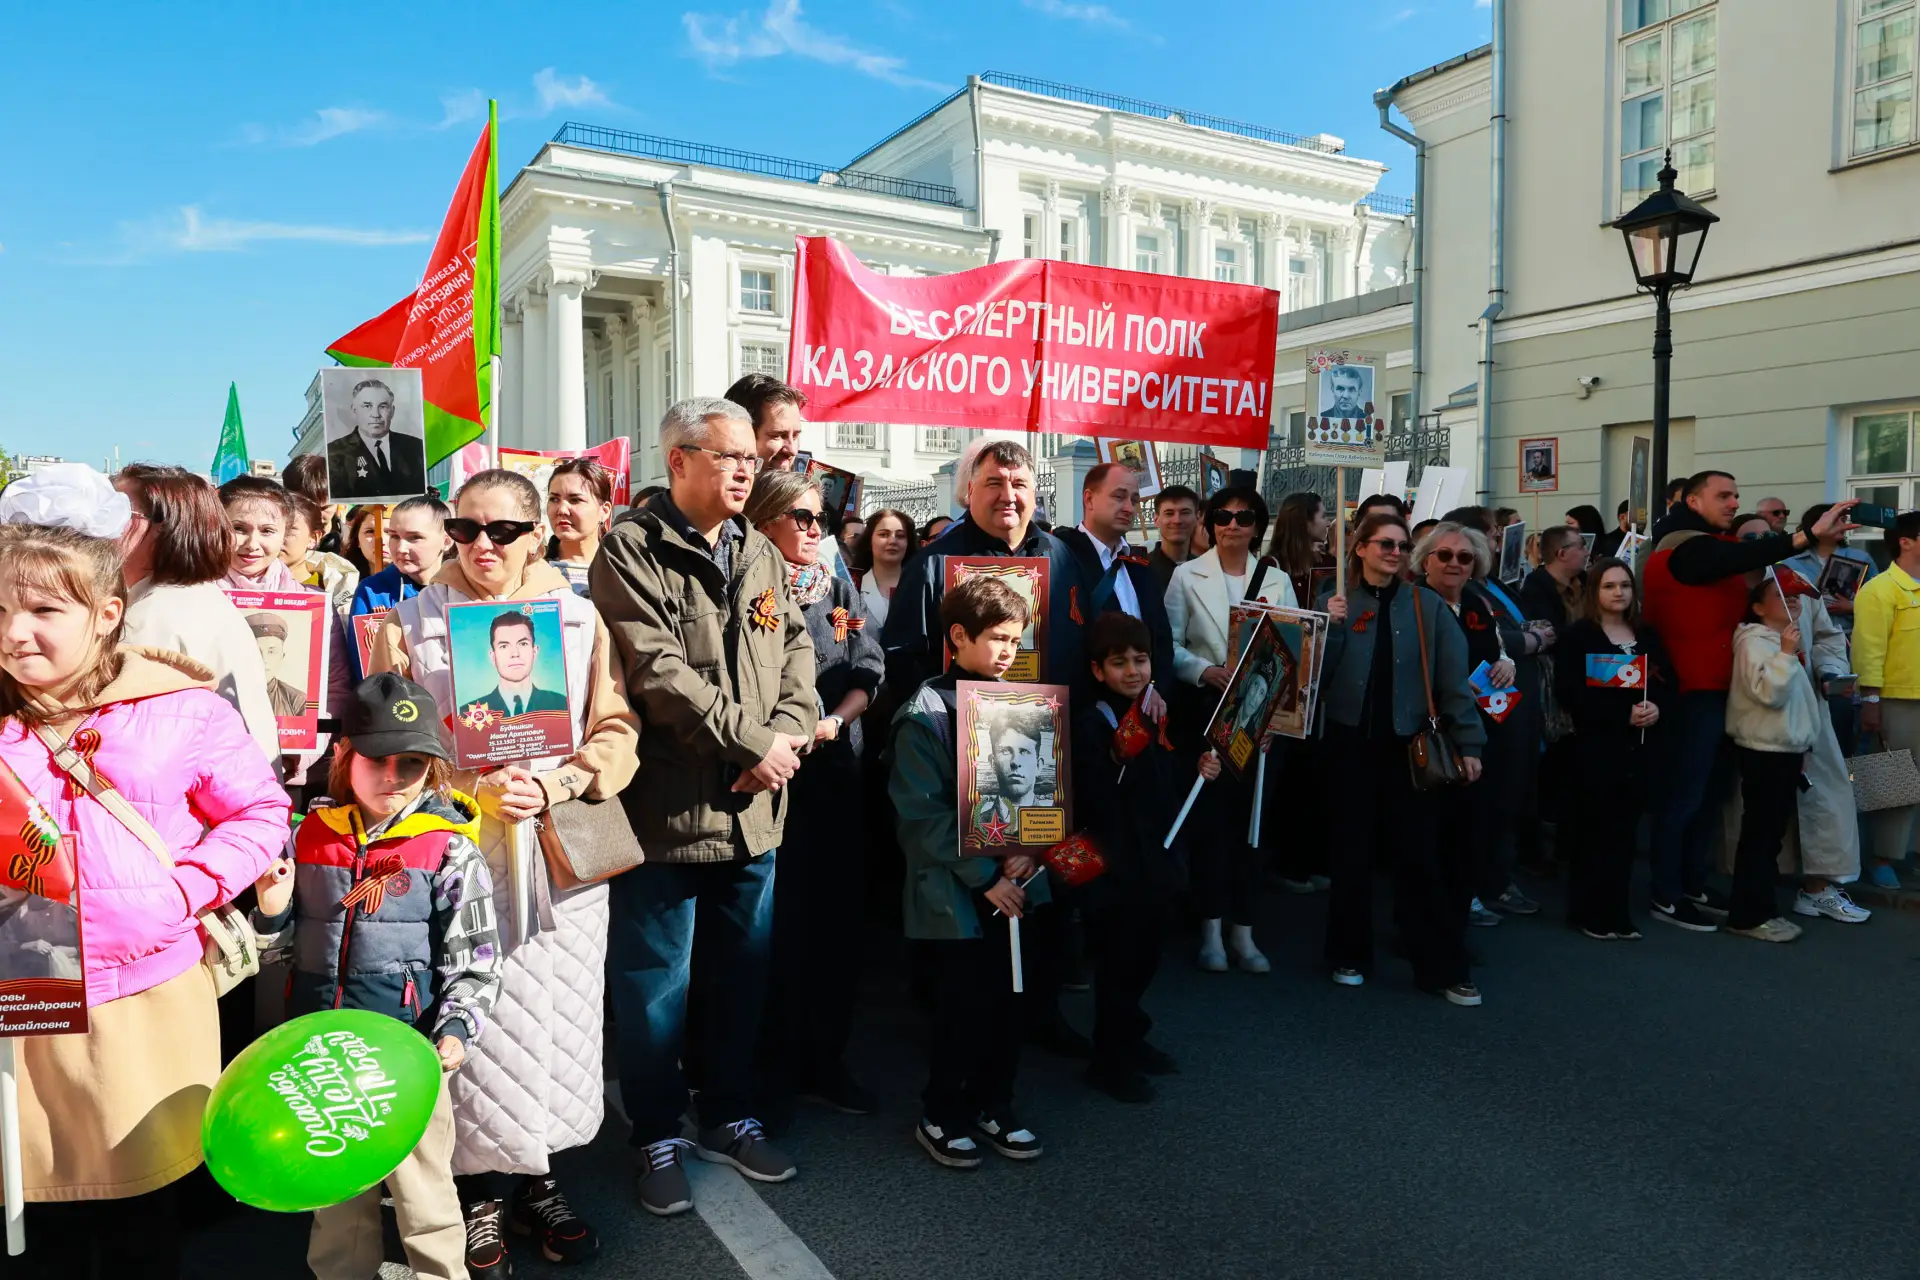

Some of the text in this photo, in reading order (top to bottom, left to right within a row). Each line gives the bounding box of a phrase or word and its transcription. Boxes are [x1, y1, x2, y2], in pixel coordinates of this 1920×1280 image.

[886, 300, 1207, 359] БЕССМЕРТНЫЙ ПОЛК
[802, 344, 1266, 419] КАЗАНСКОГО УНИВЕРСИТЕТА!
[267, 1071, 347, 1157] Спасибо
[300, 1058, 386, 1128] Деду
